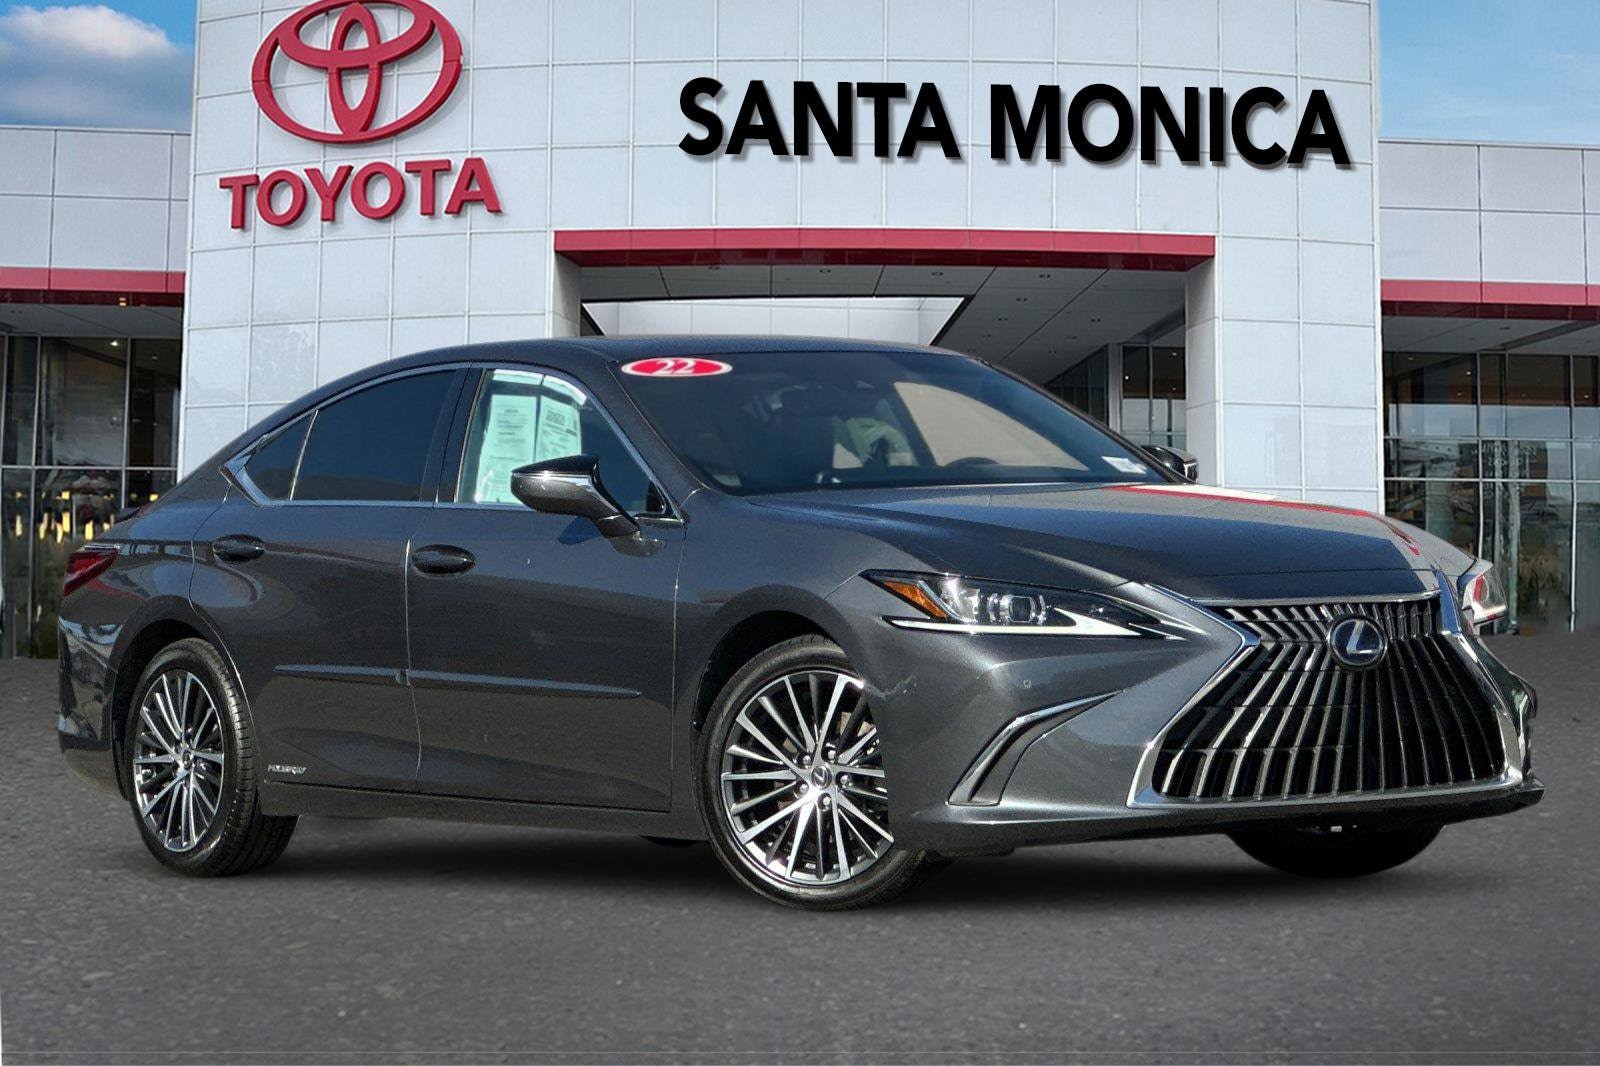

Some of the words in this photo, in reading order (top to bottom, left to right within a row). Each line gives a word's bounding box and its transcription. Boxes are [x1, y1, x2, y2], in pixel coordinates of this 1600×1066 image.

[678, 77, 962, 160] SANTA
[990, 83, 1351, 169] MONICA
[219, 157, 502, 229] TOYOTA
[651, 358, 697, 374] 22
